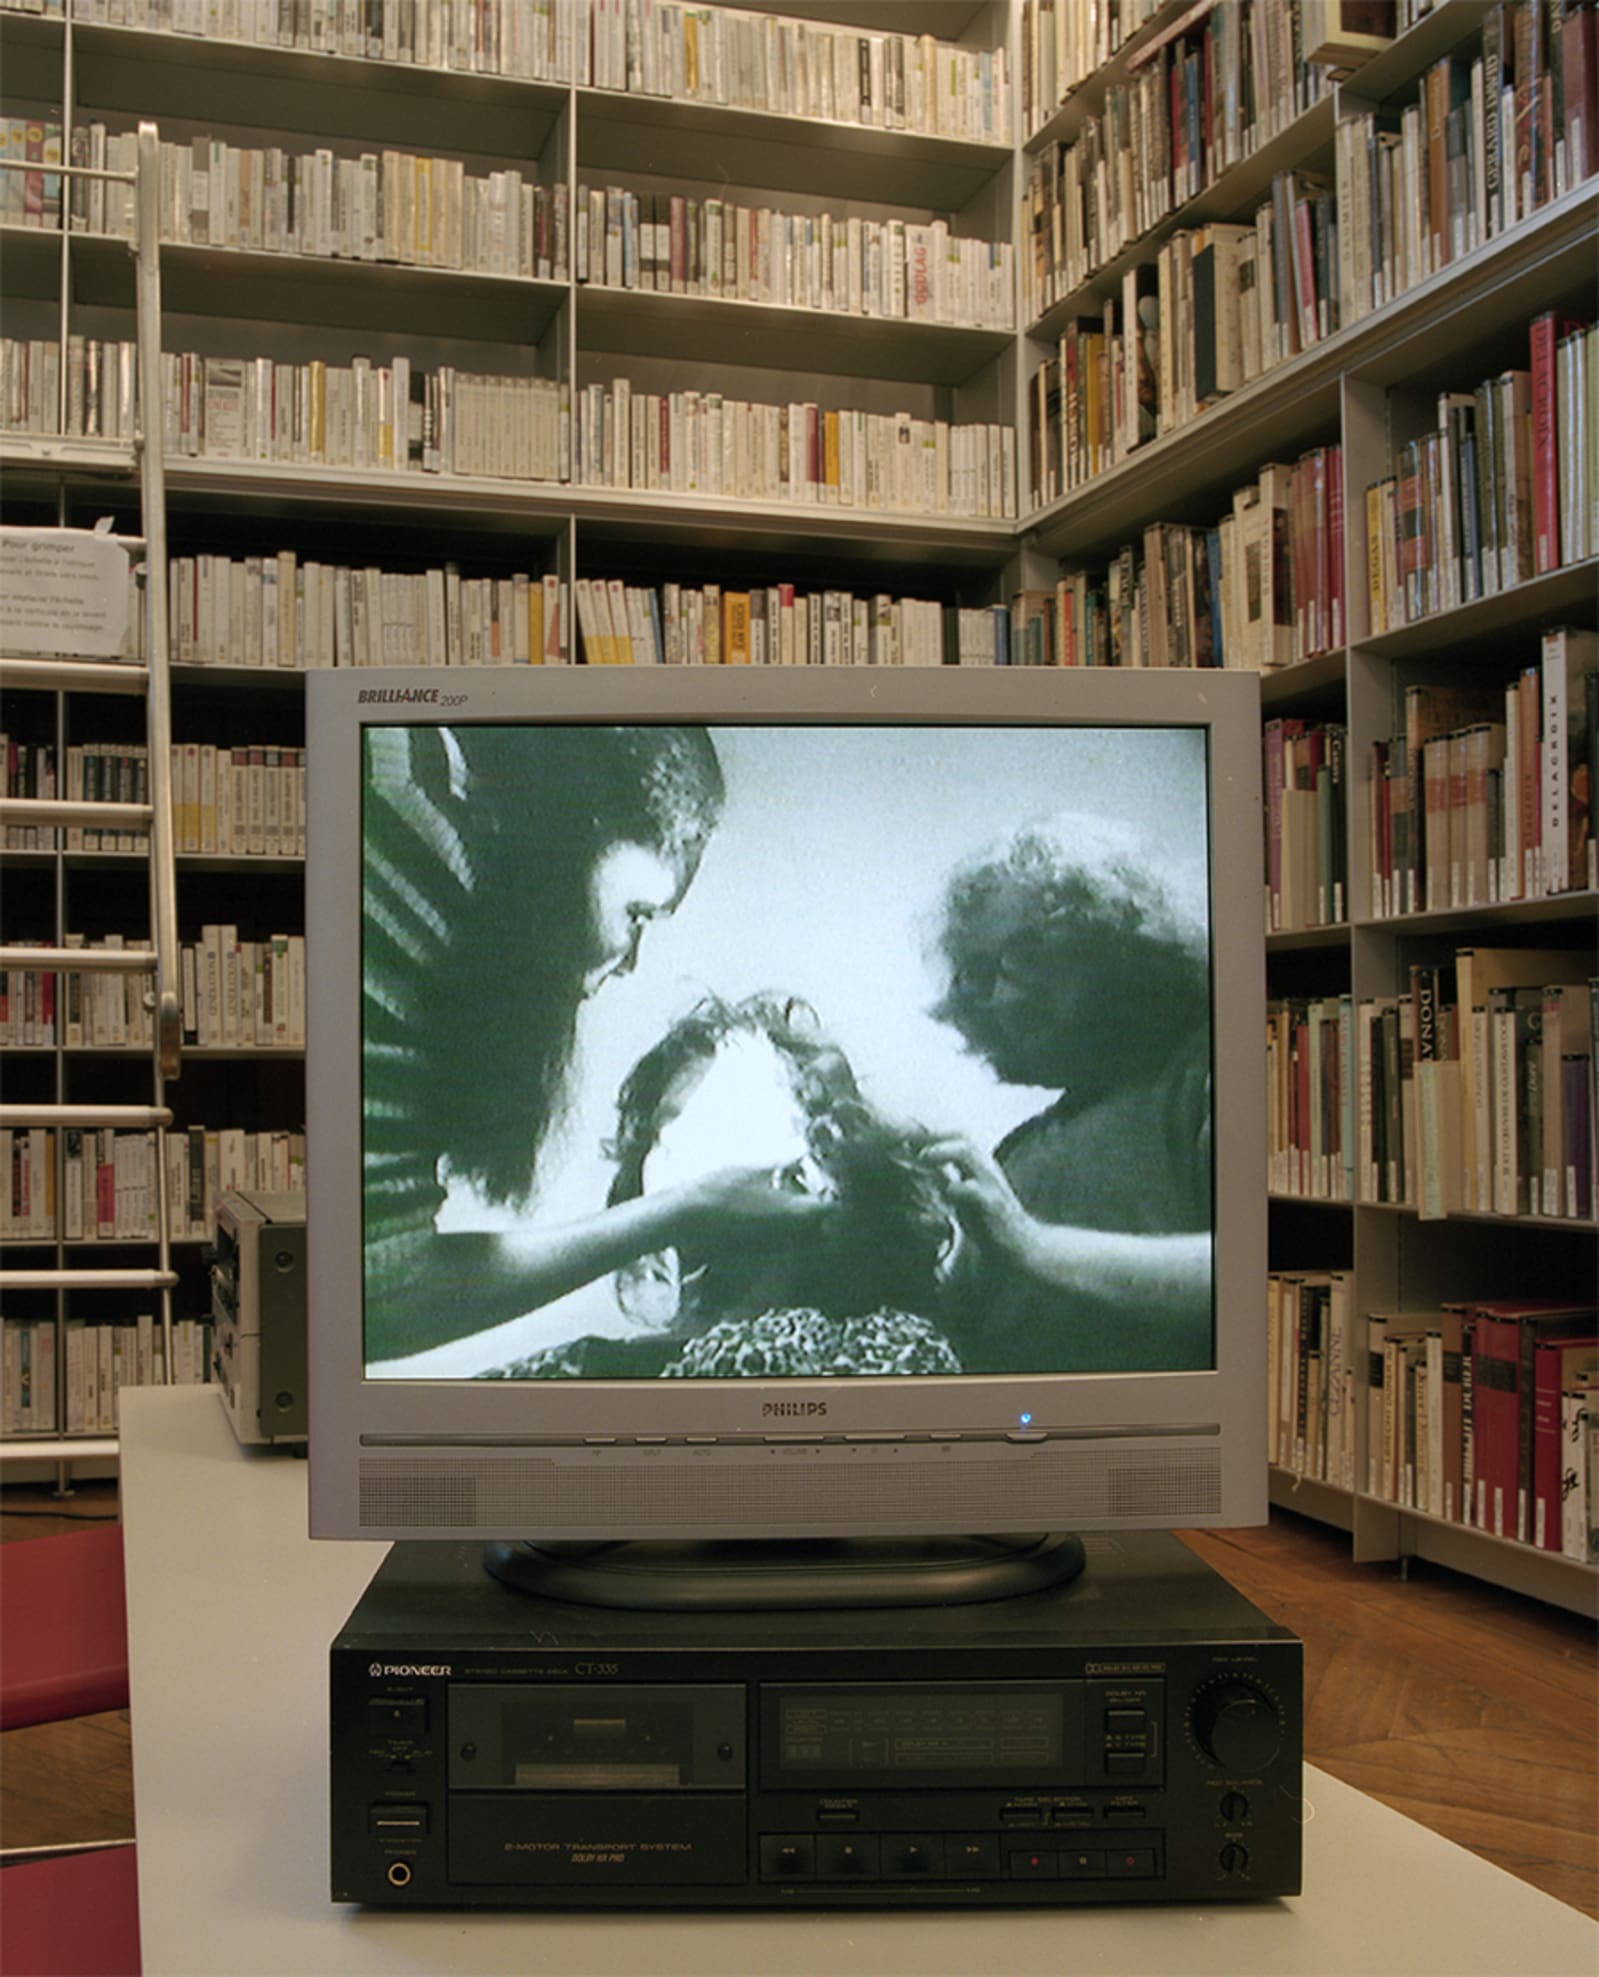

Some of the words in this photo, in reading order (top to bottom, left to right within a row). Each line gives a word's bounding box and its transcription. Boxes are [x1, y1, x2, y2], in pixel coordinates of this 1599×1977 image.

[1534, 321, 1550, 450] DELACROIX
[1371, 534, 1381, 592] DEGAS
[358, 688, 440, 704] BRILLIANCE
[762, 1402, 827, 1417] PHILIPS
[384, 1664, 452, 1677] PIONEER
[504, 1842, 560, 1851] 2-MOTOR
[564, 1842, 637, 1851] TRANSPORT
[640, 1842, 692, 1851] SYSTEM
